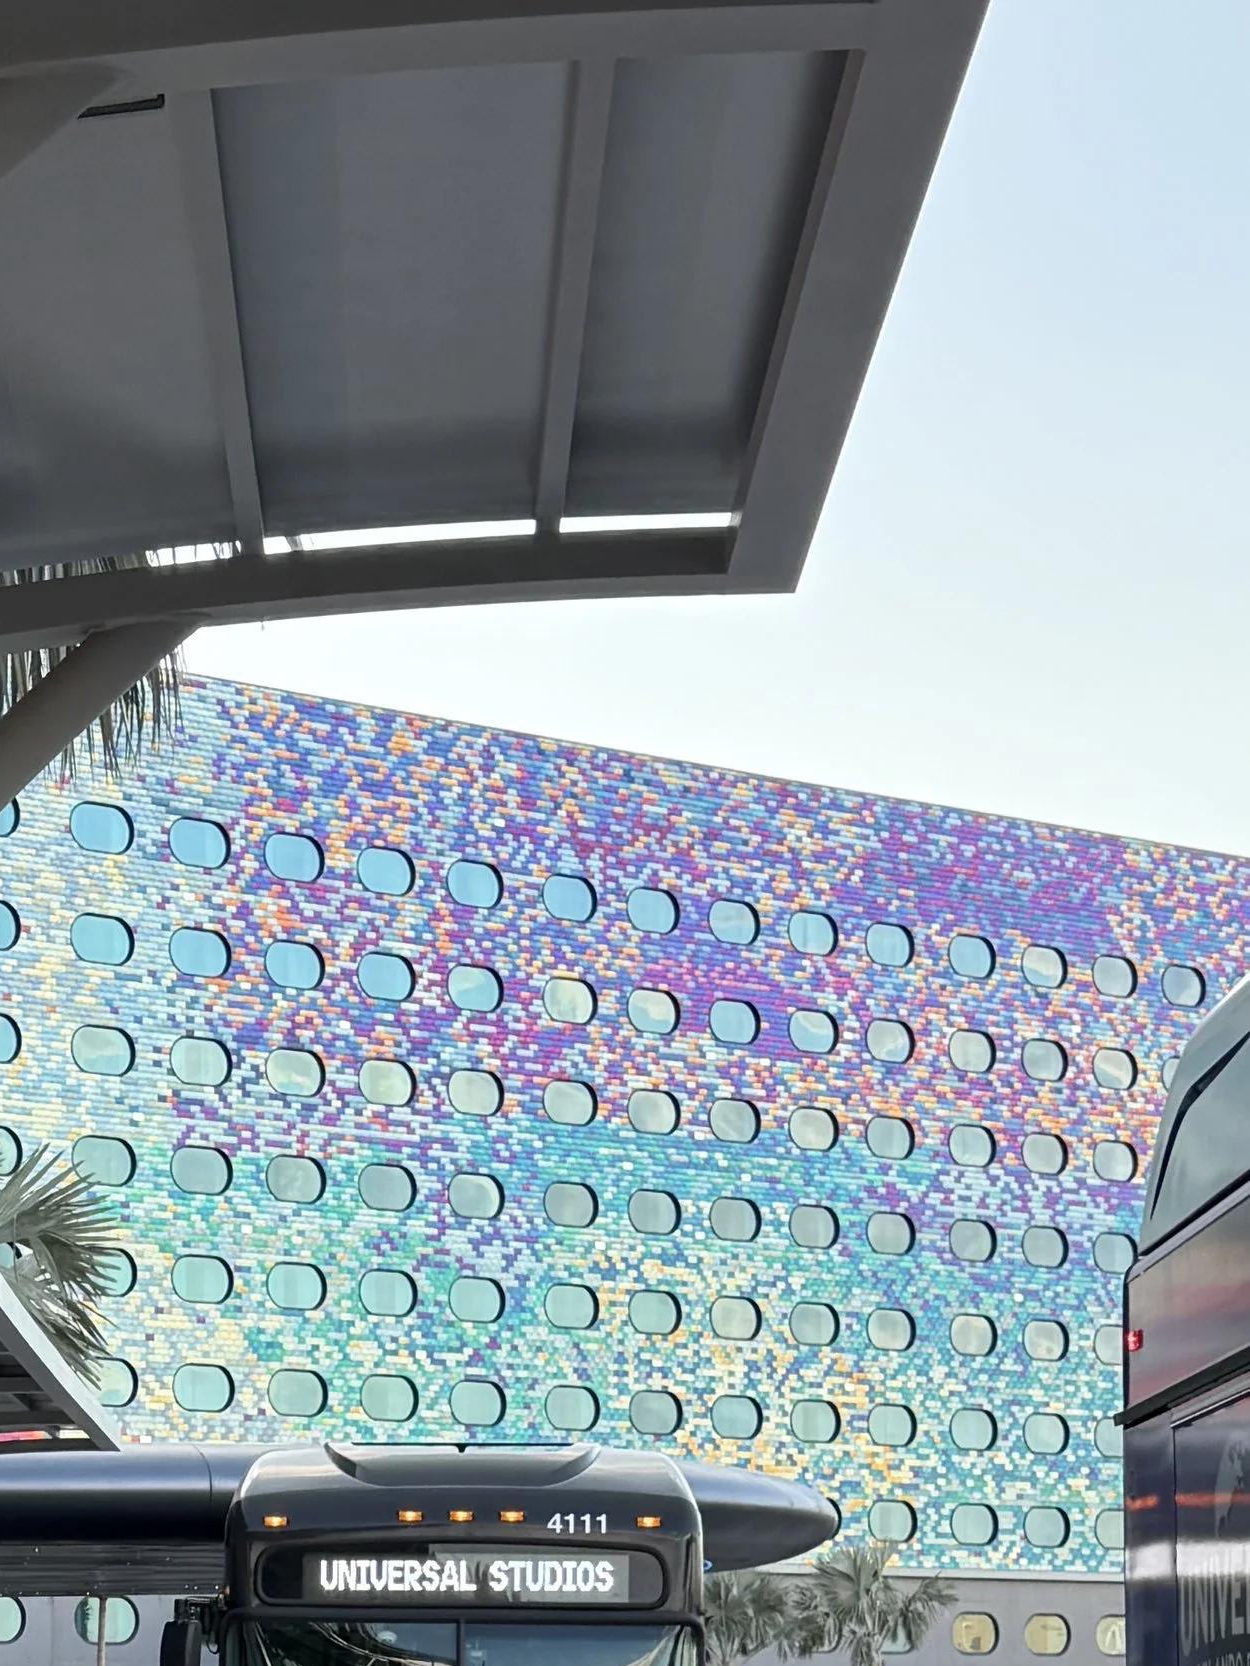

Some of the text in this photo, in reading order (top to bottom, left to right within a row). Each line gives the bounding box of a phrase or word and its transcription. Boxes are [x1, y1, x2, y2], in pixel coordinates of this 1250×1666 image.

[546, 1512, 608, 1535] 4111
[319, 1559, 615, 1593] UNIVERSAL STUDIOS
[1180, 1546, 1250, 1657] UNIVE
